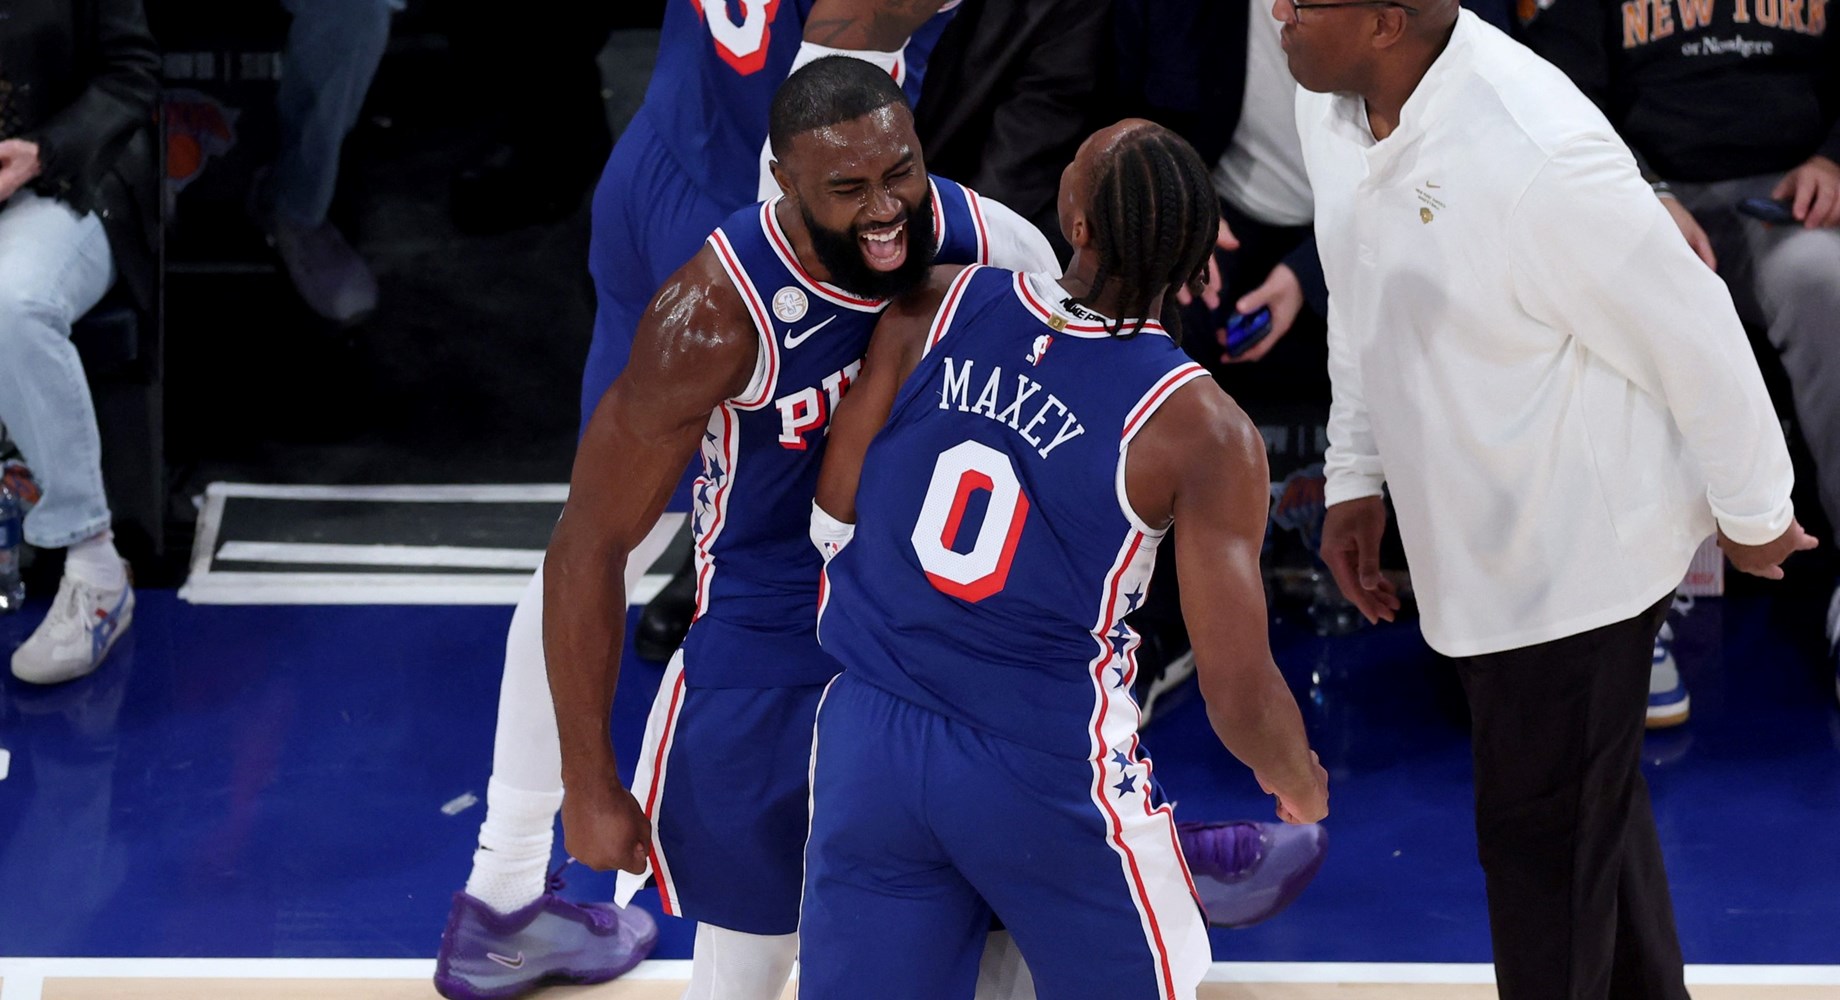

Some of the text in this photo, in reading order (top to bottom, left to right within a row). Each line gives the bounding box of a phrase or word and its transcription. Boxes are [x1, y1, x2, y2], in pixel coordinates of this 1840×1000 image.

[1622, 0, 1714, 48] NEW
[939, 357, 1085, 460] MAXEY
[910, 439, 1030, 604] 0
